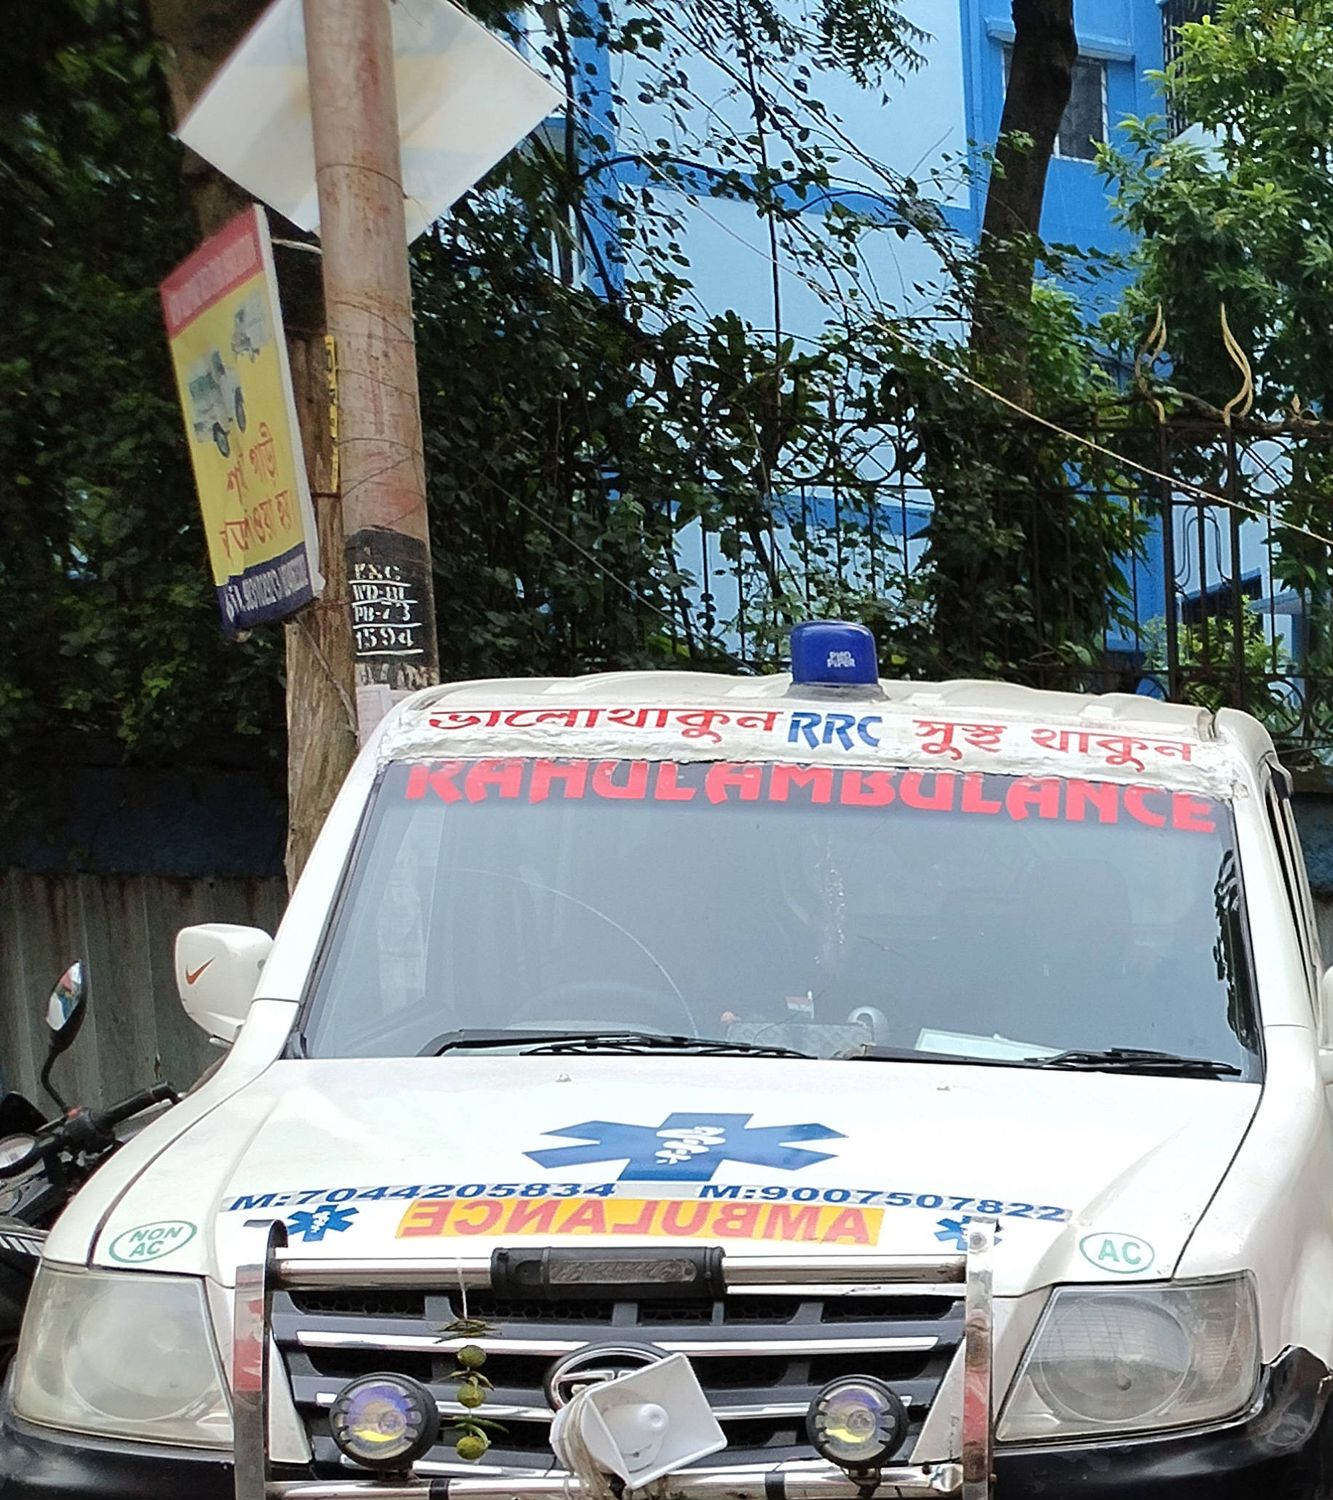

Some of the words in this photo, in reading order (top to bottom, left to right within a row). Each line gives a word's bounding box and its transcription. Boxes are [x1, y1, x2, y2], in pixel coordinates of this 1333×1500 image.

[787, 711, 883, 750] RRC
[1031, 727, 1197, 773] থাকুন
[228, 1183, 617, 1211] M:7044205834
[699, 1184, 1067, 1222] M:9007507822
[129, 1226, 184, 1243] NON
[129, 1241, 164, 1257] AC
[1098, 1239, 1142, 1265] AC
